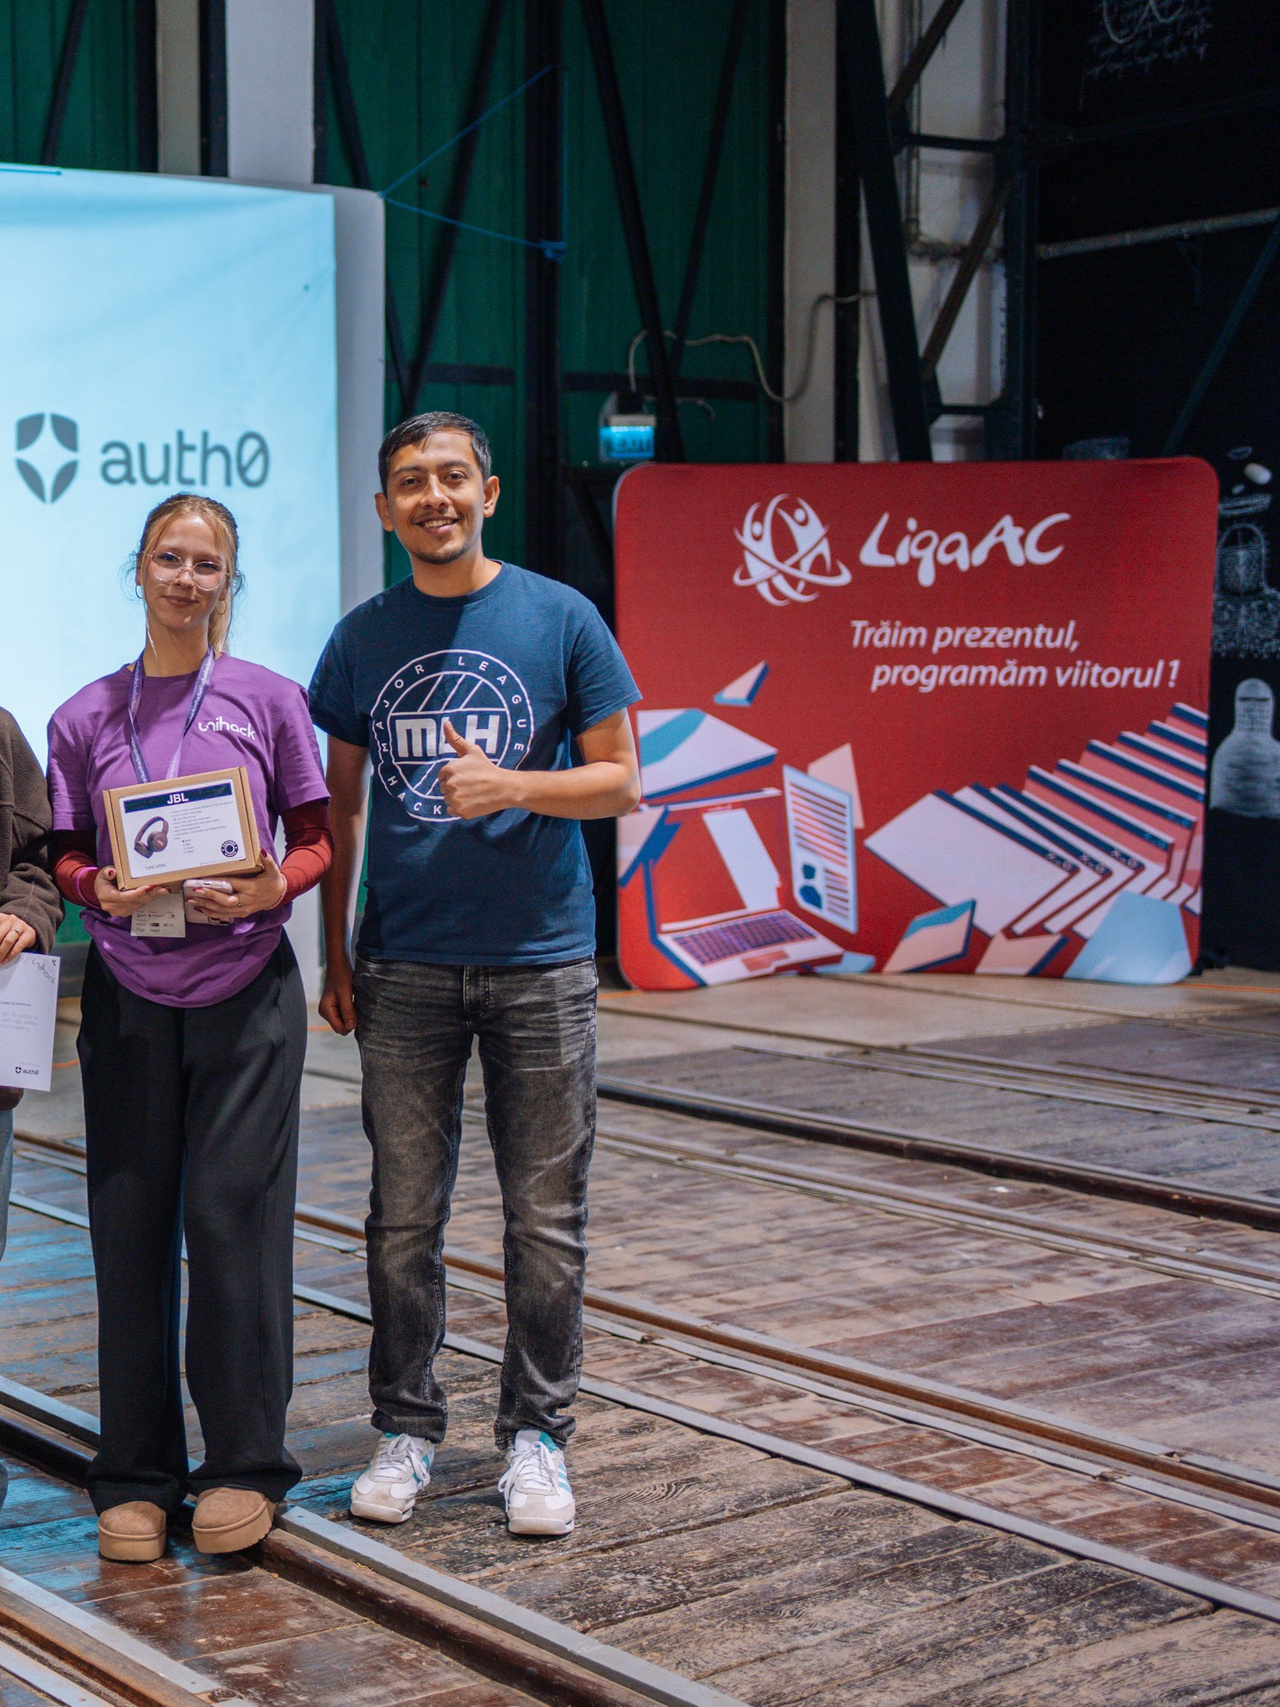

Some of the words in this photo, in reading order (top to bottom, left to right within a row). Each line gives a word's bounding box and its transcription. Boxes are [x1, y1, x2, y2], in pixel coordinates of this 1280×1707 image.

[100, 429, 269, 488] auth0
[850, 620, 927, 648] Trăim
[932, 620, 1079, 654] prezentul,
[871, 658, 1048, 693] programăm
[376, 664, 425, 753] MAJOR
[458, 656, 527, 752] LEAGUE
[198, 716, 256, 740] unihack
[166, 792, 189, 805] JBL
